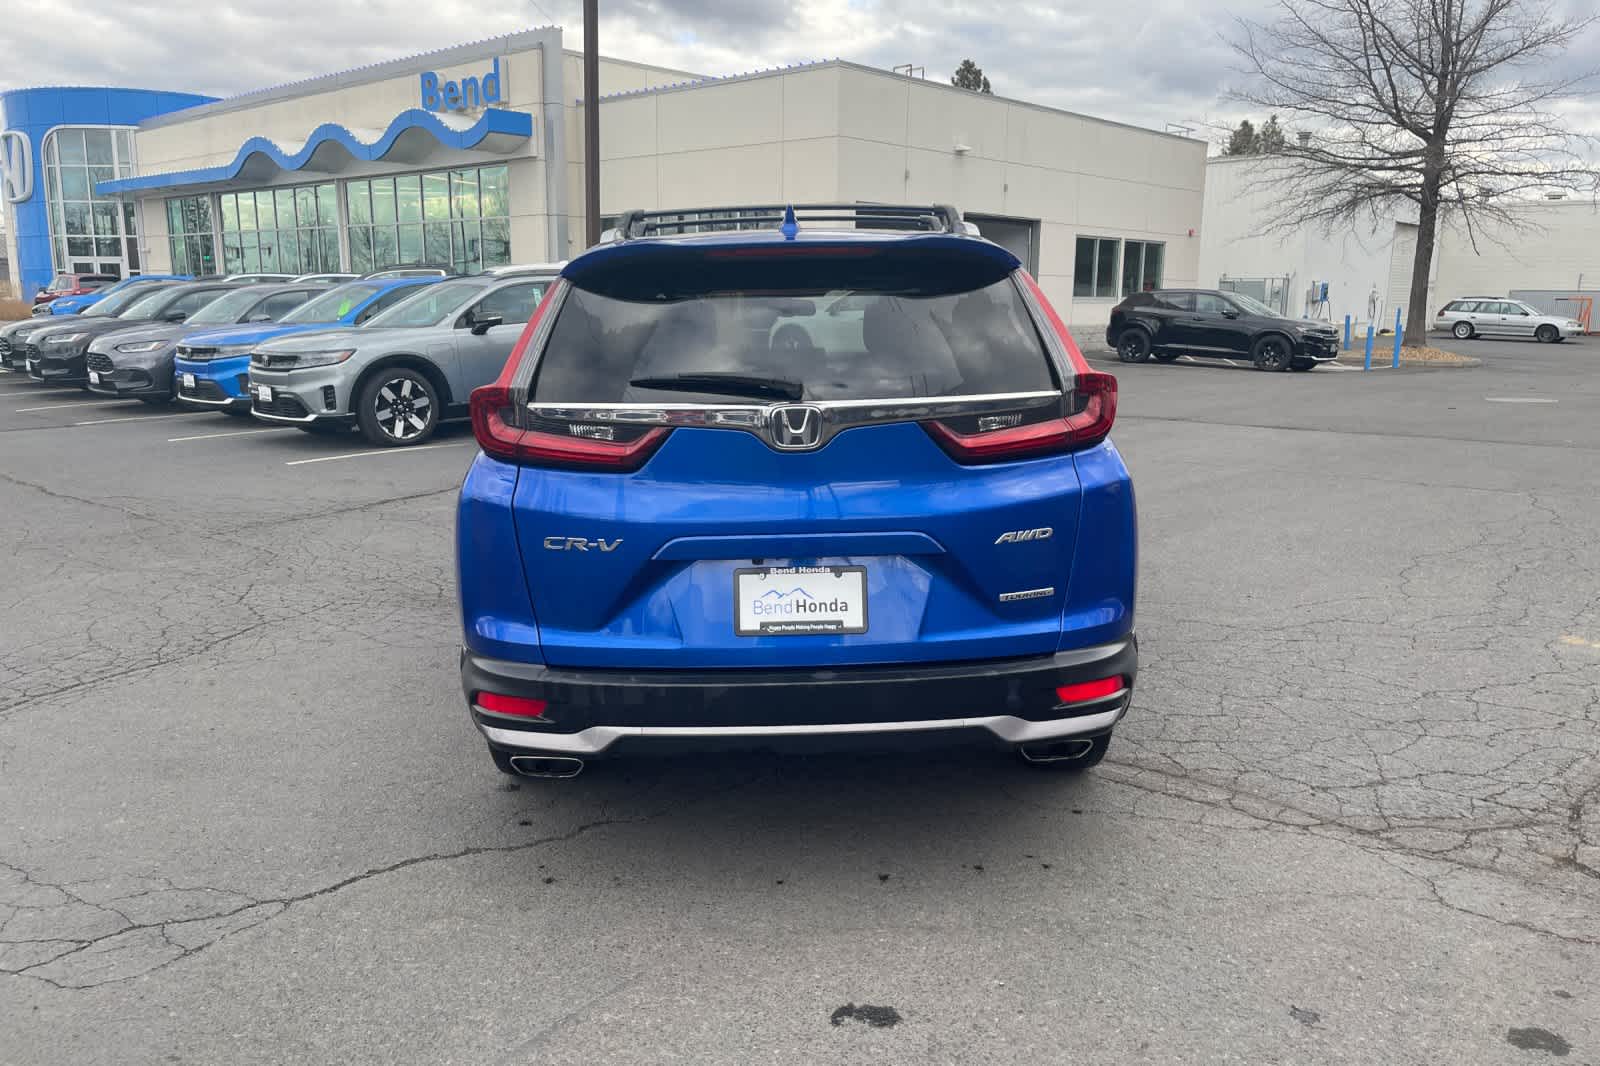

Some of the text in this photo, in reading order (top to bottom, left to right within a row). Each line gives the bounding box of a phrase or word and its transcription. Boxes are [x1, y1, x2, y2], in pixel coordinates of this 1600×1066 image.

[420, 56, 500, 113] Bend
[543, 536, 624, 552] CR-V
[994, 527, 1054, 545] AWD
[769, 566, 831, 576] Bend Honda
